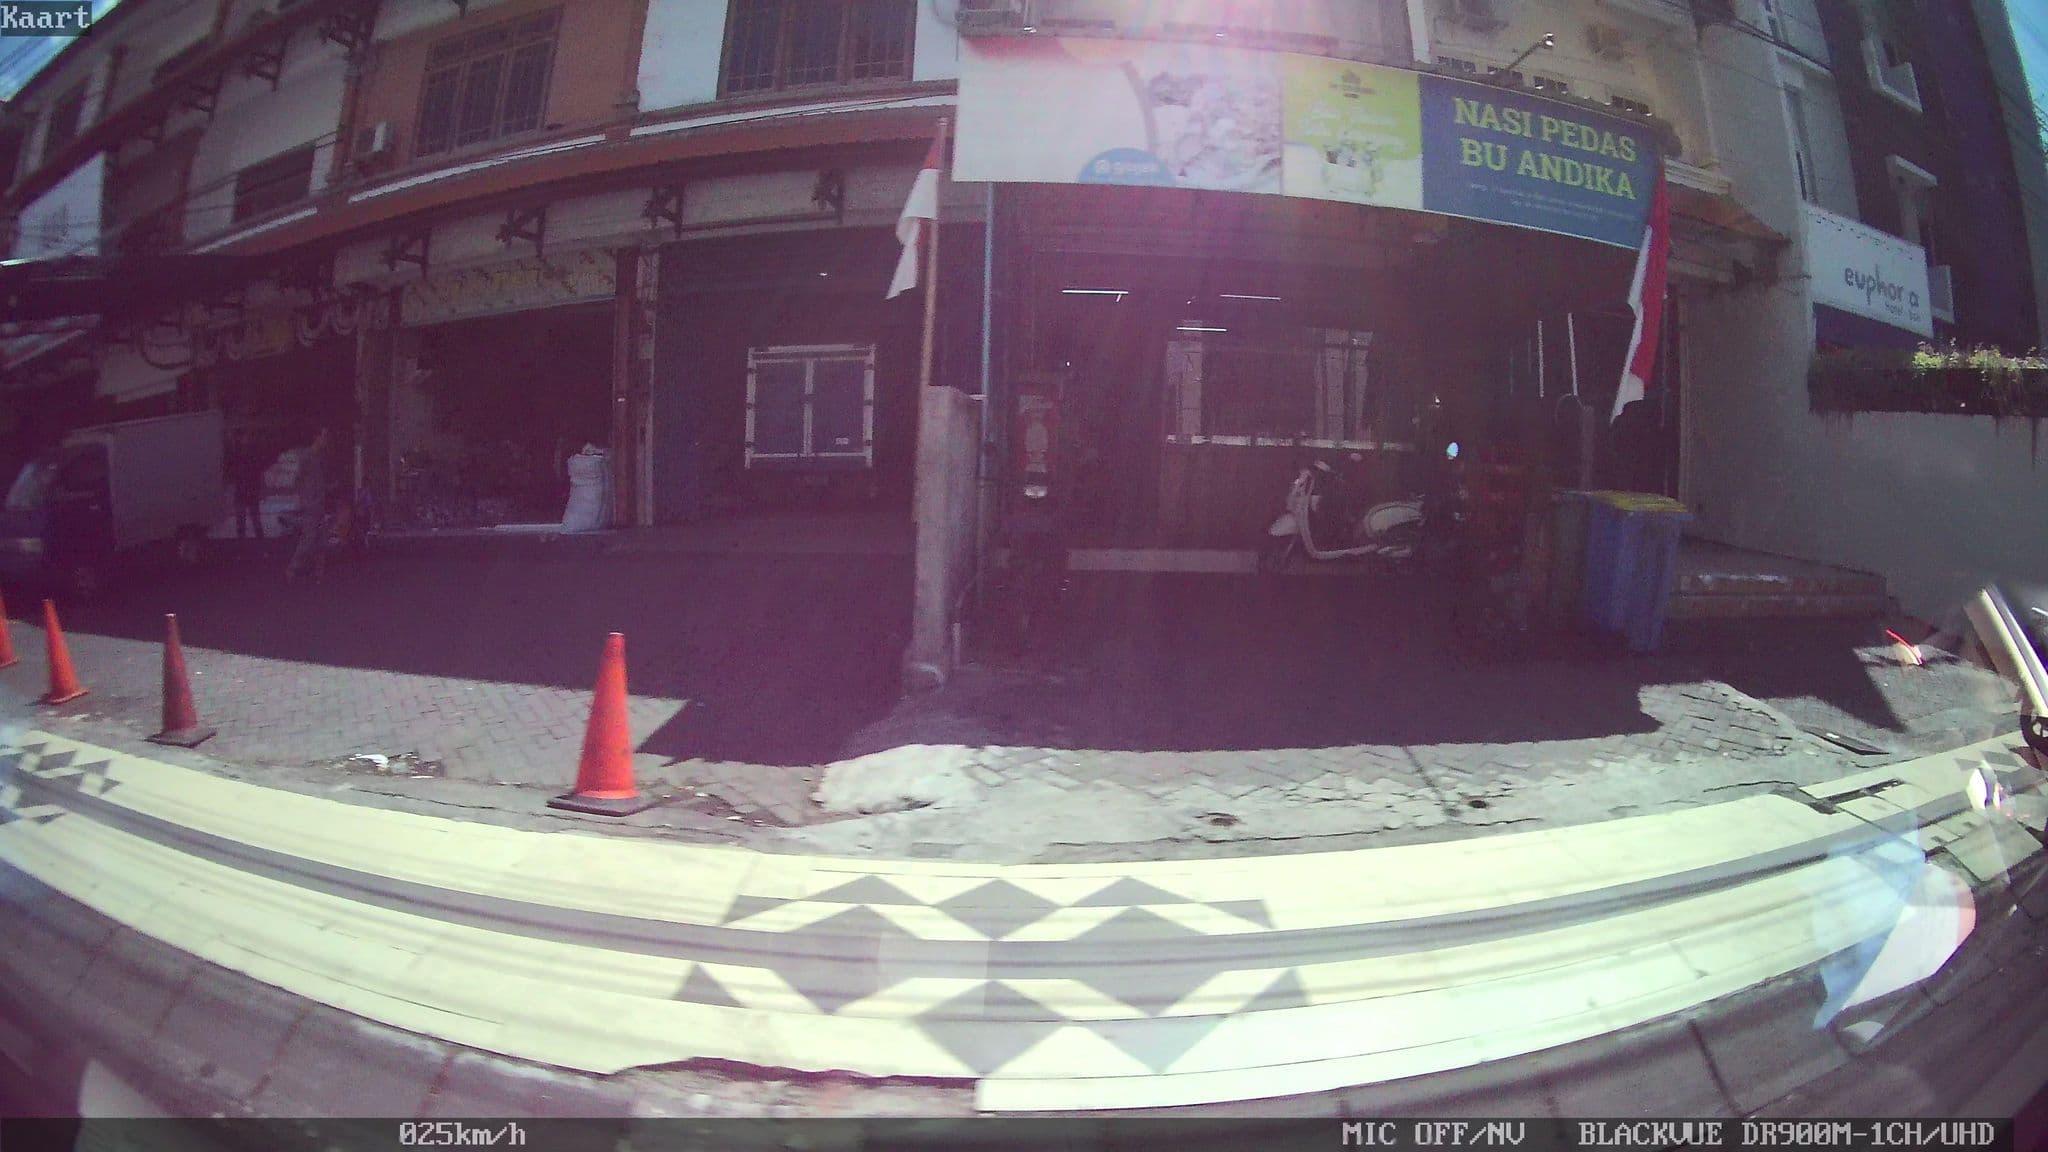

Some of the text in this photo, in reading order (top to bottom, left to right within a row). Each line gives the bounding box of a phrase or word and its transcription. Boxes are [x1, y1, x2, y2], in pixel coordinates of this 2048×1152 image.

[1454, 97, 1637, 162] NASI PEDAS
[1460, 137, 1637, 200] BU ANDIKA
